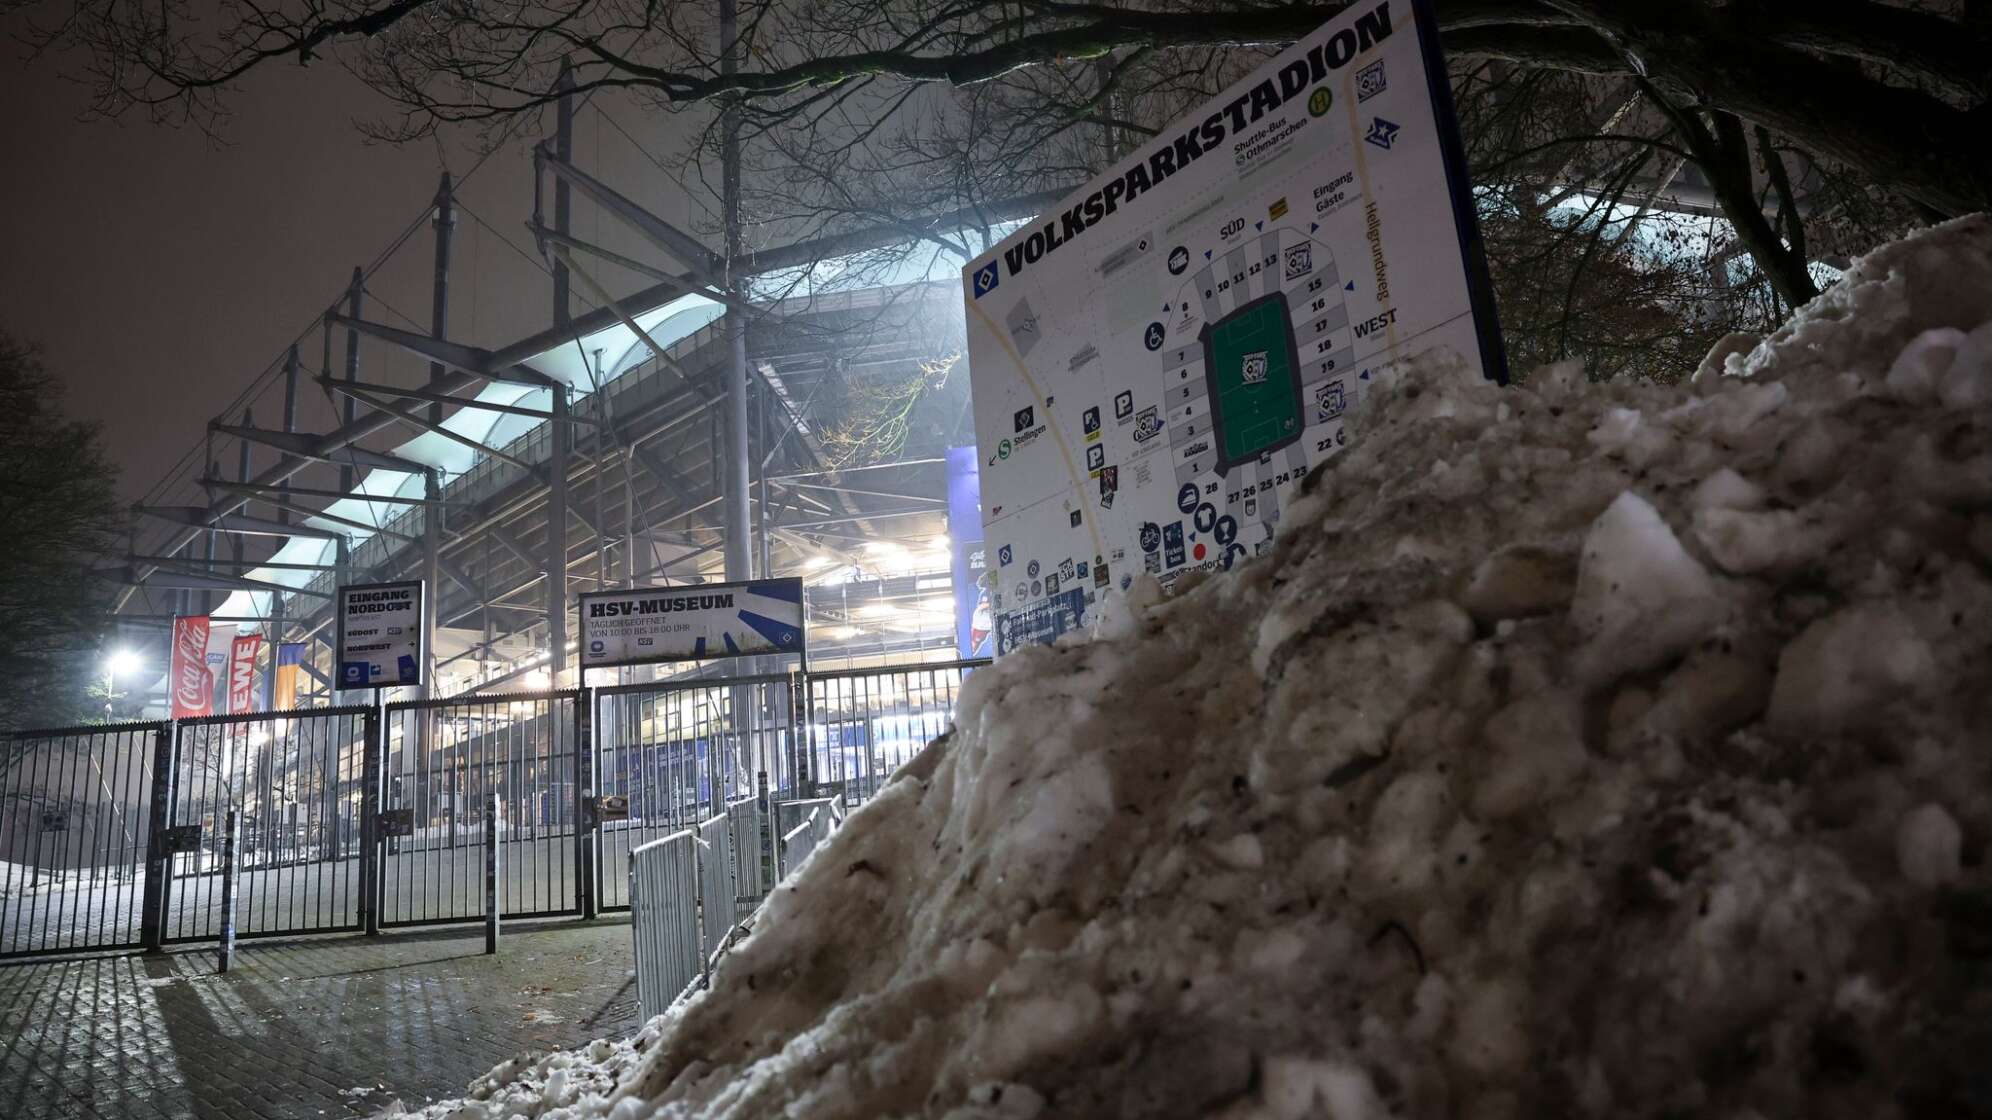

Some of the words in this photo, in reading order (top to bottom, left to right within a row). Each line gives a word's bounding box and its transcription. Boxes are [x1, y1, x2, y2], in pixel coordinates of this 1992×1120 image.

[1003, 2, 1393, 276] VOLKSPARKSTADION
[1233, 115, 1287, 155] Shuttle-Bus
[1245, 116, 1308, 160] Othmarschen
[1313, 171, 1354, 199] Eingang
[1316, 191, 1345, 213] Gäste
[1219, 217, 1246, 241] SÜD
[1365, 201, 1389, 302] Hellgrundweg
[1264, 254, 1277, 267] 13
[1248, 263, 1261, 276] 12
[1232, 272, 1245, 285] 11
[1308, 278, 1322, 292] 15
[1217, 280, 1230, 293] 10
[1205, 289, 1212, 299] 9
[1311, 298, 1325, 312] 16
[1315, 319, 1328, 333] 17
[1353, 308, 1397, 338] WEST
[1317, 340, 1332, 353] 18
[1178, 352, 1185, 361] 7
[1321, 359, 1335, 373] 19
[1180, 369, 1187, 378] 6
[1183, 388, 1189, 397] 5
[1185, 406, 1192, 415] 4
[1013, 424, 1047, 446] Stellingen
[1317, 438, 1332, 452] 22
[1191, 462, 1199, 472] 1
[1293, 466, 1307, 479] 23
[1276, 472, 1290, 485] 24
[1205, 482, 1218, 494] 28
[1243, 485, 1256, 498] 26
[1260, 479, 1273, 492] 25
[1228, 491, 1240, 504] 27
[349, 590, 410, 603] EINGANG
[348, 601, 412, 615] NORDOST
[590, 593, 734, 618] HSV-MUSEUM
[590, 629, 608, 638] VON
[634, 626, 647, 636] BIS
[674, 624, 690, 633] UHR
[232, 639, 257, 716] EWE
